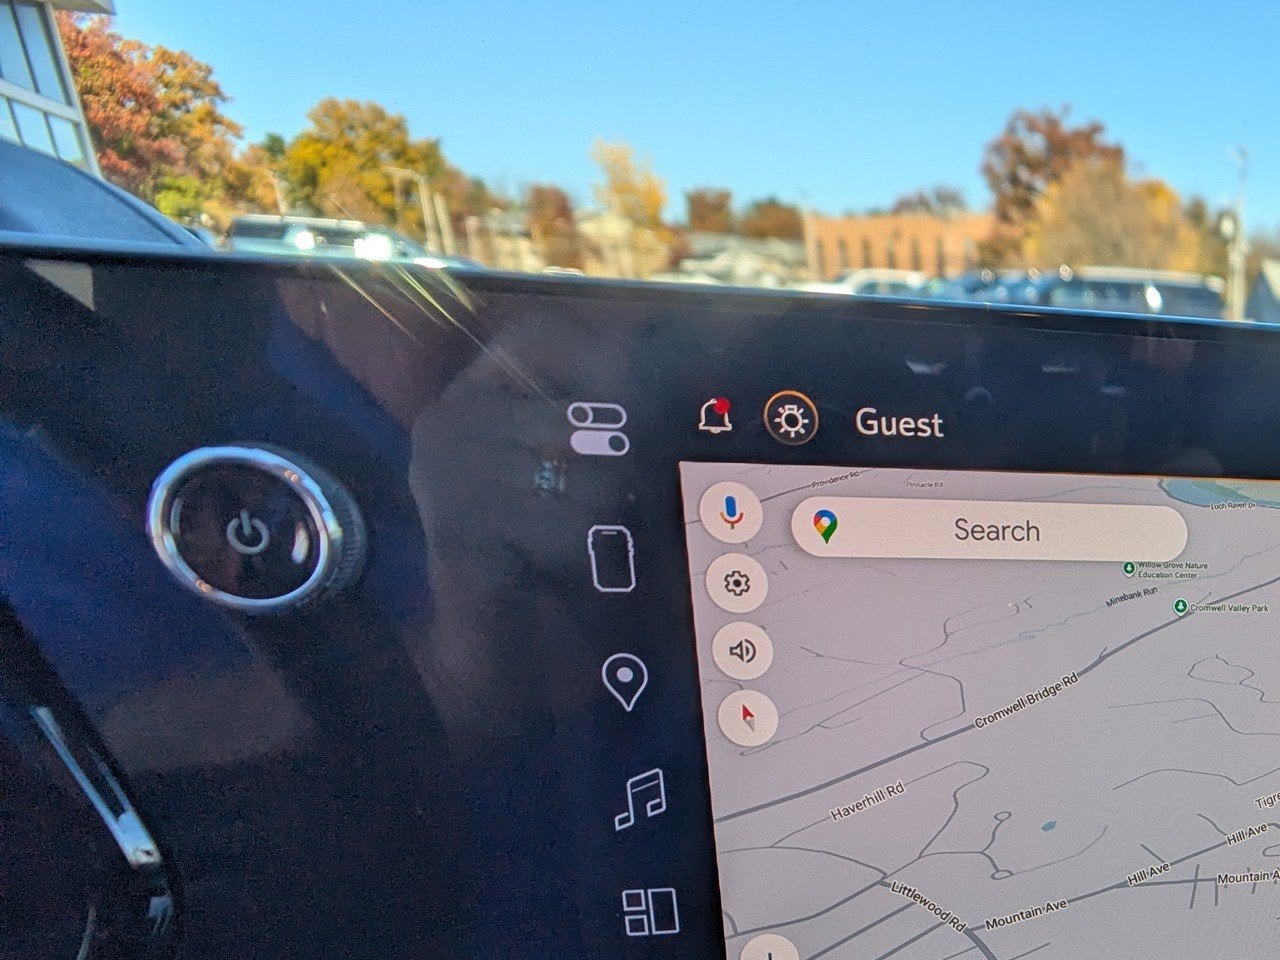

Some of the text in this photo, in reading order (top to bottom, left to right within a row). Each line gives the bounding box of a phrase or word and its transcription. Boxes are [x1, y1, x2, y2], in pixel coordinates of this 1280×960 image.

[855, 407, 944, 438] Guest
[1210, 502, 1227, 510] Loch
[1228, 501, 1247, 509] Raven
[954, 518, 1040, 542] Search
[1138, 571, 1197, 579] Education Center
[1185, 562, 1208, 570] Nature
[1106, 586, 1158, 608] Minebank Run
[1190, 604, 1269, 614] Cromwell Valley Park
[975, 672, 1079, 728] Cromwell Bridge Rd
[831, 782, 905, 822] Haverhill Rd
[1227, 823, 1268, 846] Hill Ave
[1127, 862, 1170, 886] Hill Ave
[1217, 871, 1270, 885] Mountain
[891, 881, 967, 933] Littlewood Rd
[985, 899, 1068, 931] Mountain Ave
